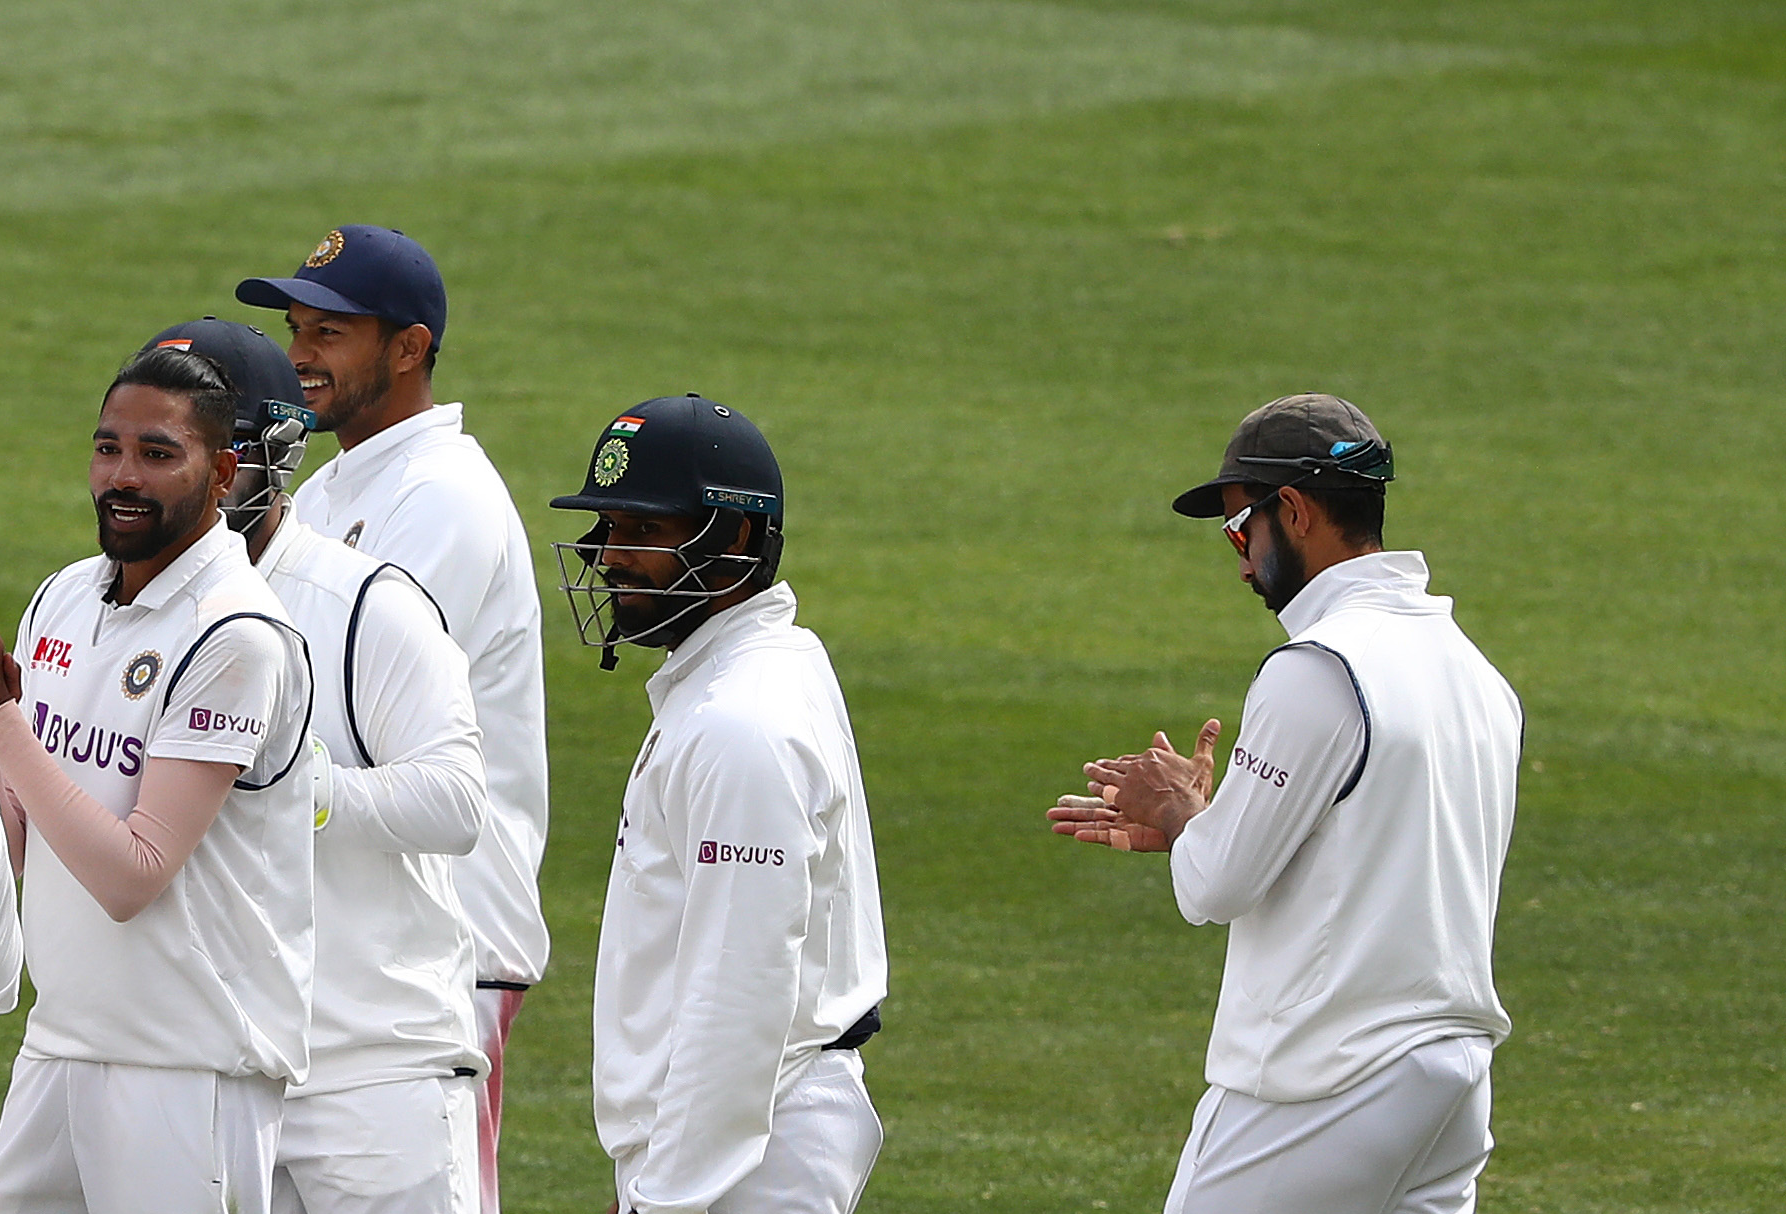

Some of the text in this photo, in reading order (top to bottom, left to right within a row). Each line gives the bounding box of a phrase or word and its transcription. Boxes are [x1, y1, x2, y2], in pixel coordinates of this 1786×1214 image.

[718, 491, 753, 505] SHREY
[45, 713, 144, 777] BYJU'S
[1234, 747, 1289, 788] BYJU'S
[720, 844, 785, 866] BYJU'S
